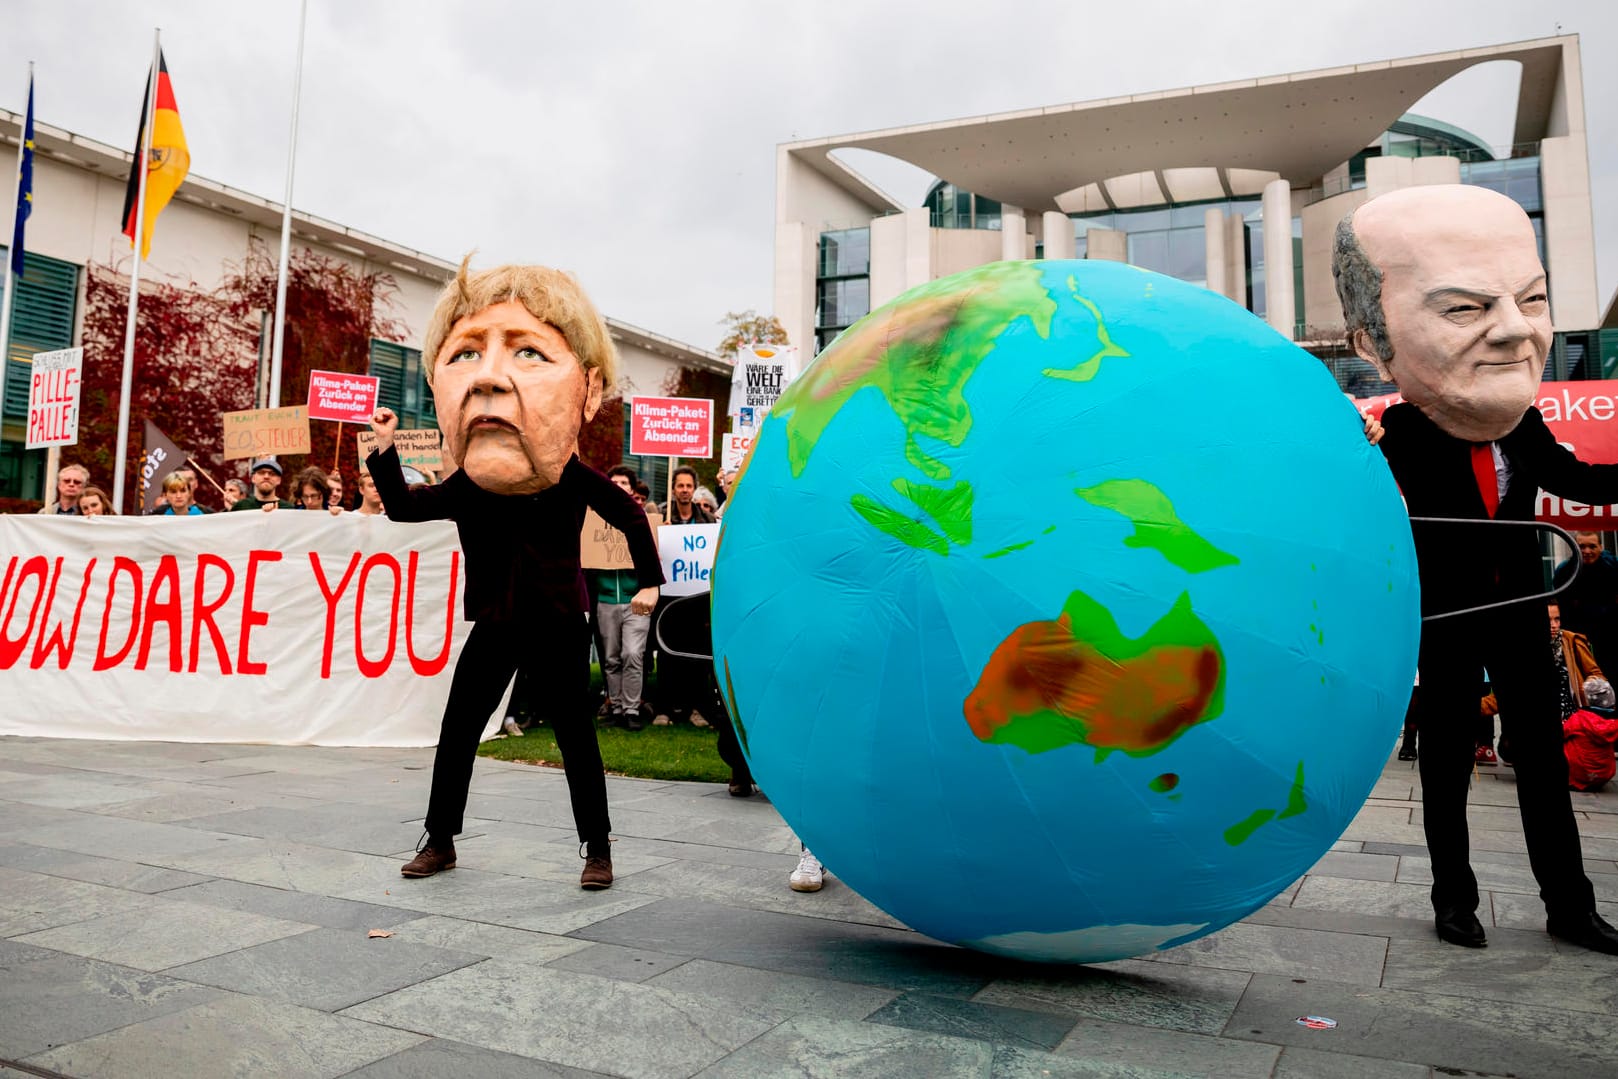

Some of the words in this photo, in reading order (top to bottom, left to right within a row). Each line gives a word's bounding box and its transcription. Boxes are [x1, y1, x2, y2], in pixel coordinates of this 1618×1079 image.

[772, 365, 784, 374] DIE
[32, 368, 80, 405] PILLE-
[313, 376, 375, 393] Klima-Paket:
[746, 373, 783, 387] WELT
[318, 388, 353, 400] Zurück
[354, 394, 367, 402] an
[746, 387, 762, 395] EINE
[764, 387, 782, 395] BANK
[319, 398, 367, 412] Absender
[635, 403, 707, 418] Klima-Paket:
[1531, 389, 1618, 421] ake
[30, 405, 76, 444] PALLE!
[642, 417, 682, 430] Zurück
[684, 421, 699, 431] an
[644, 430, 699, 443] Absender
[683, 534, 707, 552] NO
[672, 558, 713, 582] Pille
[93, 550, 283, 675] DARE
[308, 550, 459, 679] YOU
